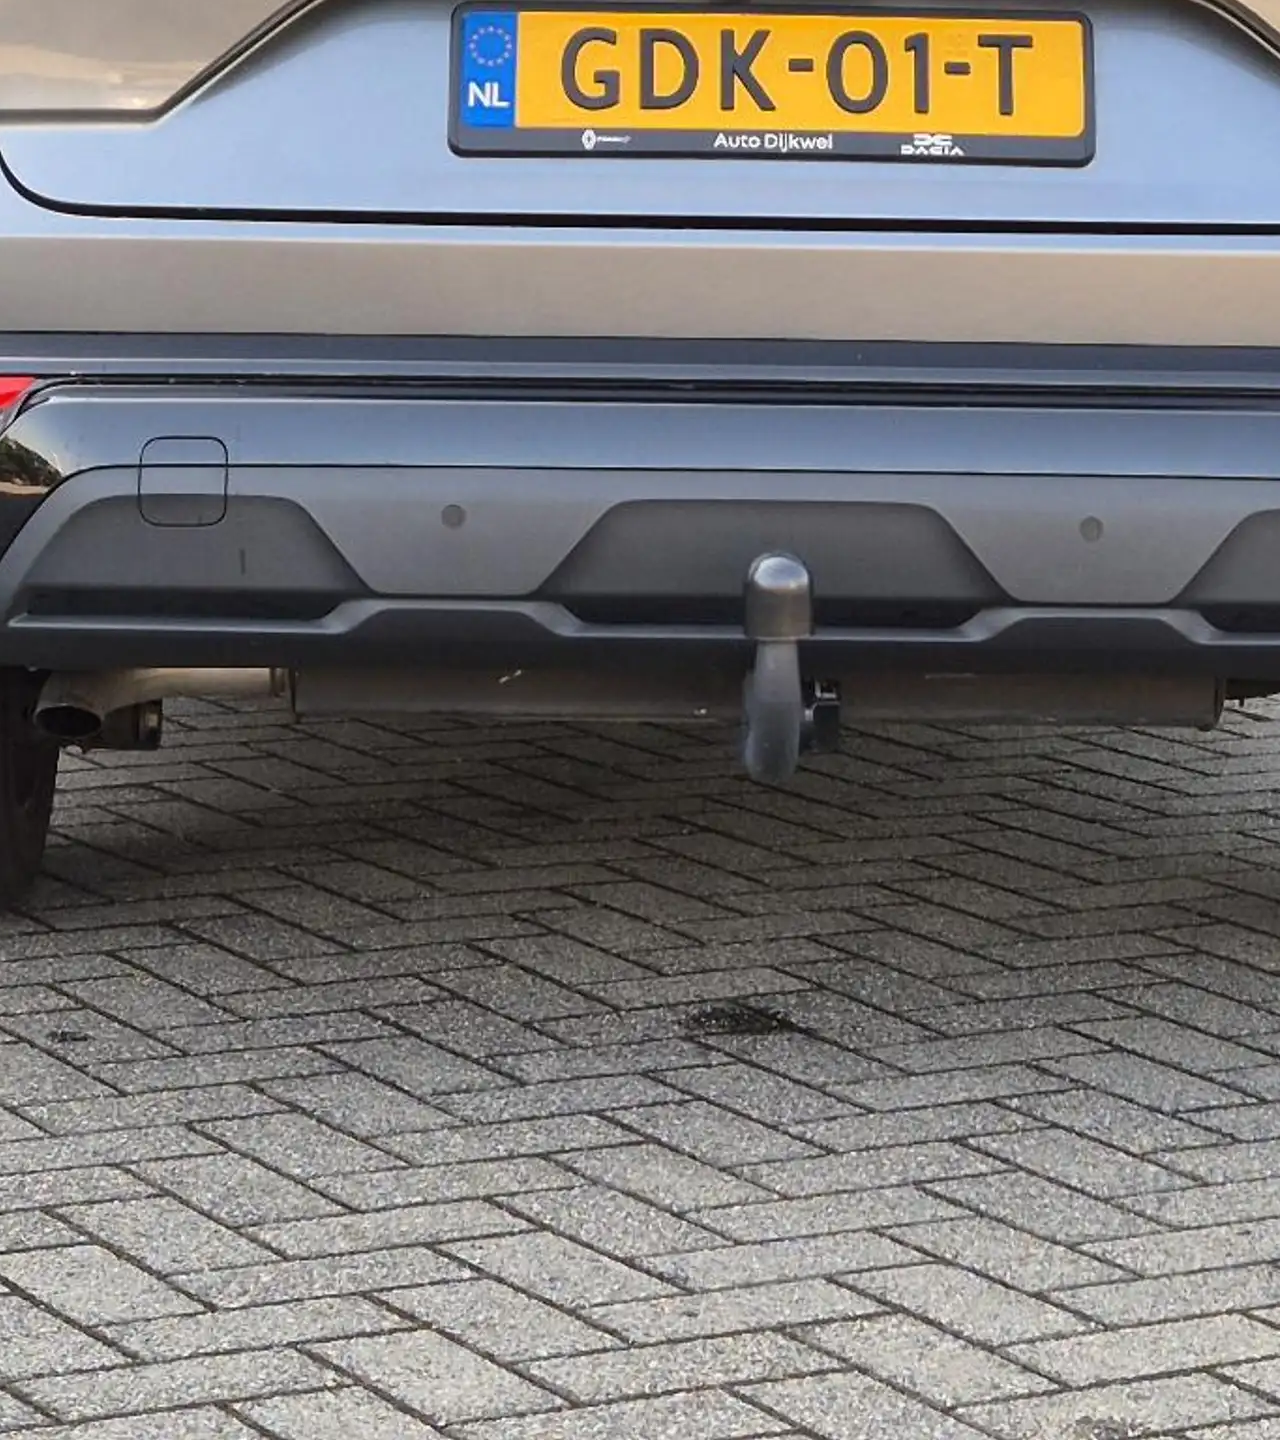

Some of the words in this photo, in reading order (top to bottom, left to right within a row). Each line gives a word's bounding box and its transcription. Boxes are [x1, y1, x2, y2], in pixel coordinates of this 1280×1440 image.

[560, 26, 1034, 116] GDK-01-T
[467, 81, 510, 109] NL
[713, 132, 761, 149] Auto
[900, 144, 965, 157] DACIA
